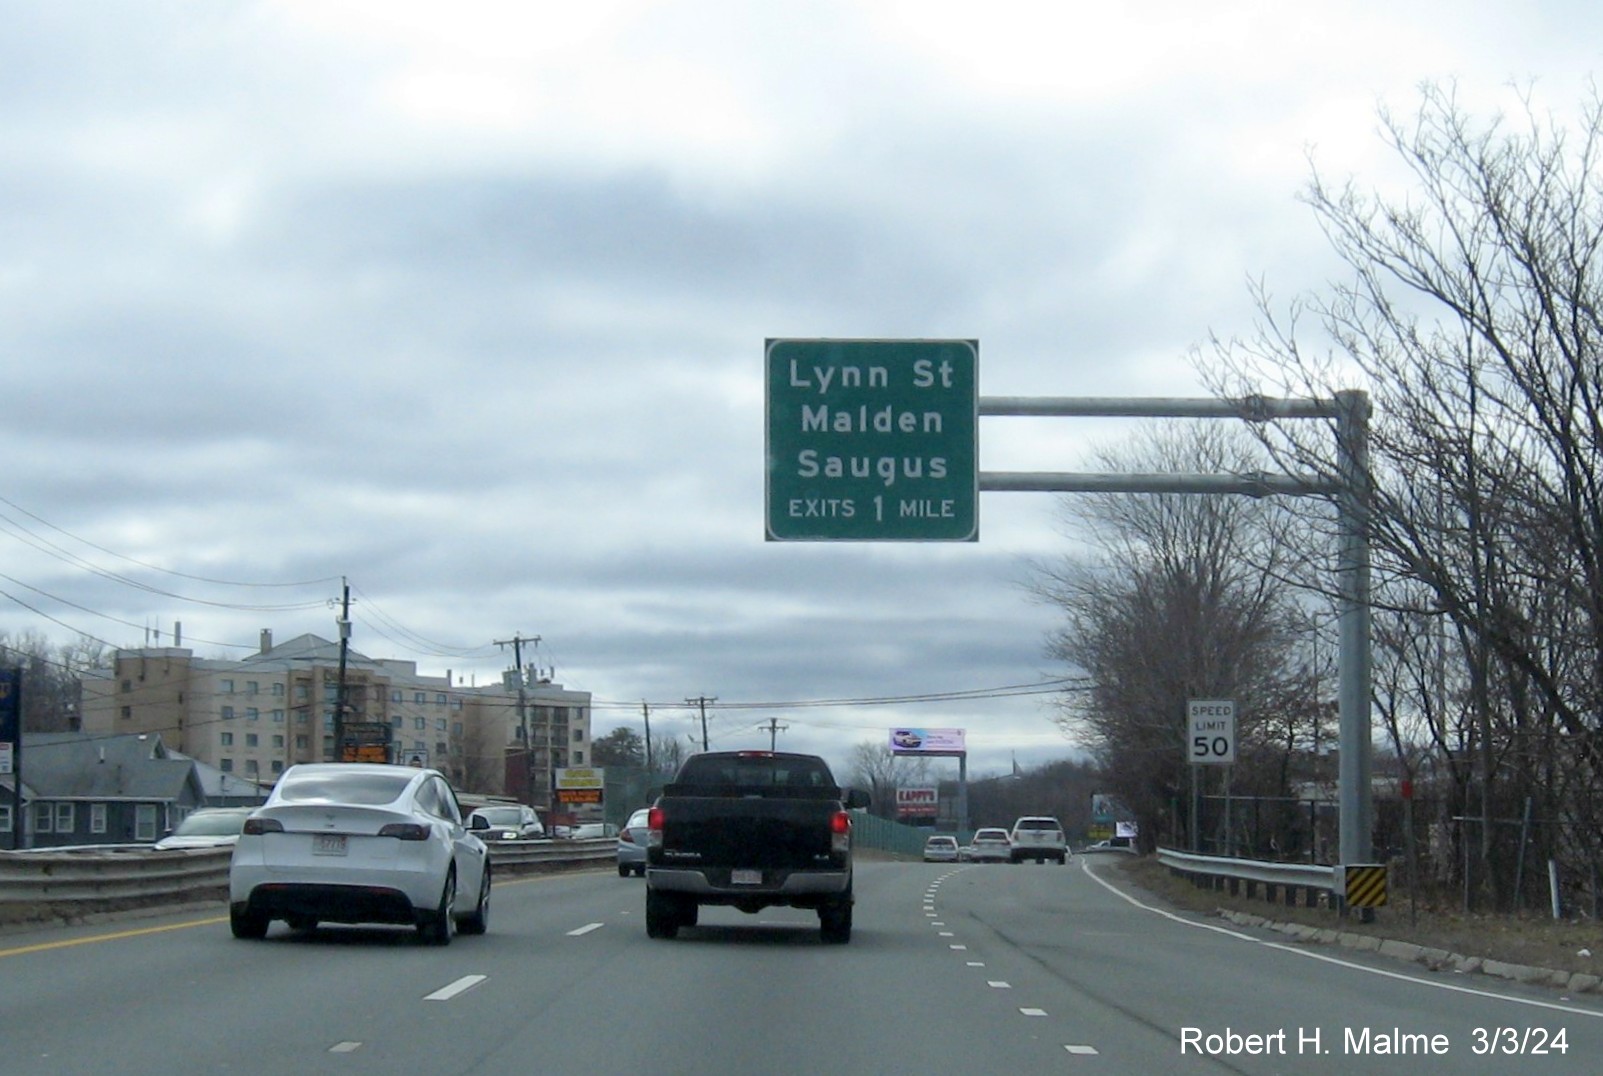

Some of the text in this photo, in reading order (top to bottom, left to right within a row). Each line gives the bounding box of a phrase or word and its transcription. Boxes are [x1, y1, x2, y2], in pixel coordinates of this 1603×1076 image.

[790, 359, 953, 394] Lynn St
[802, 405, 942, 432] Malden
[798, 449, 947, 486] Saugus
[789, 495, 955, 521] EXITS 1 MILE
[1192, 706, 1231, 716] SPEED
[1196, 722, 1227, 731] LIMIT
[1194, 737, 1229, 757] 50
